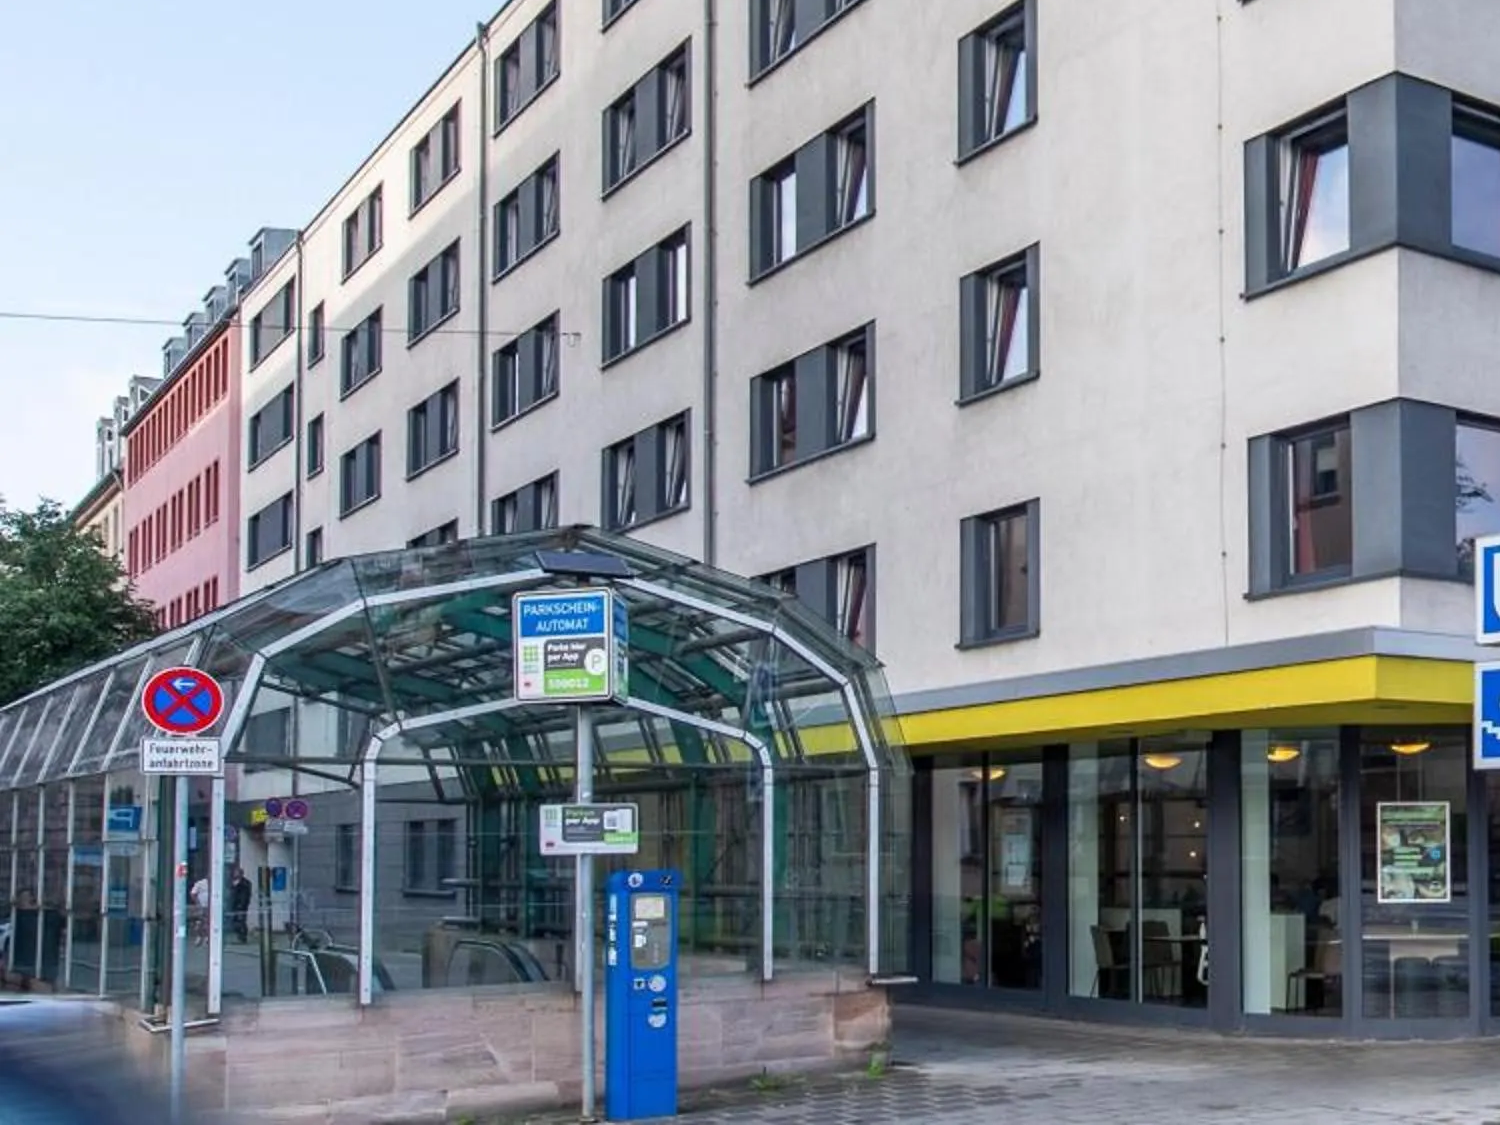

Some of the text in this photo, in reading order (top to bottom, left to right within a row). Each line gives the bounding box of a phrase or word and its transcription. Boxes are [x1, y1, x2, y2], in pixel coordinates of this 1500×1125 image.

[523, 601, 600, 617] PARKSCHEIN-
[535, 618, 588, 633] AUTOMAT
[562, 652, 579, 662] App
[149, 742, 213, 753] Feuerwehr-
[150, 758, 213, 769] anfahrtzone
